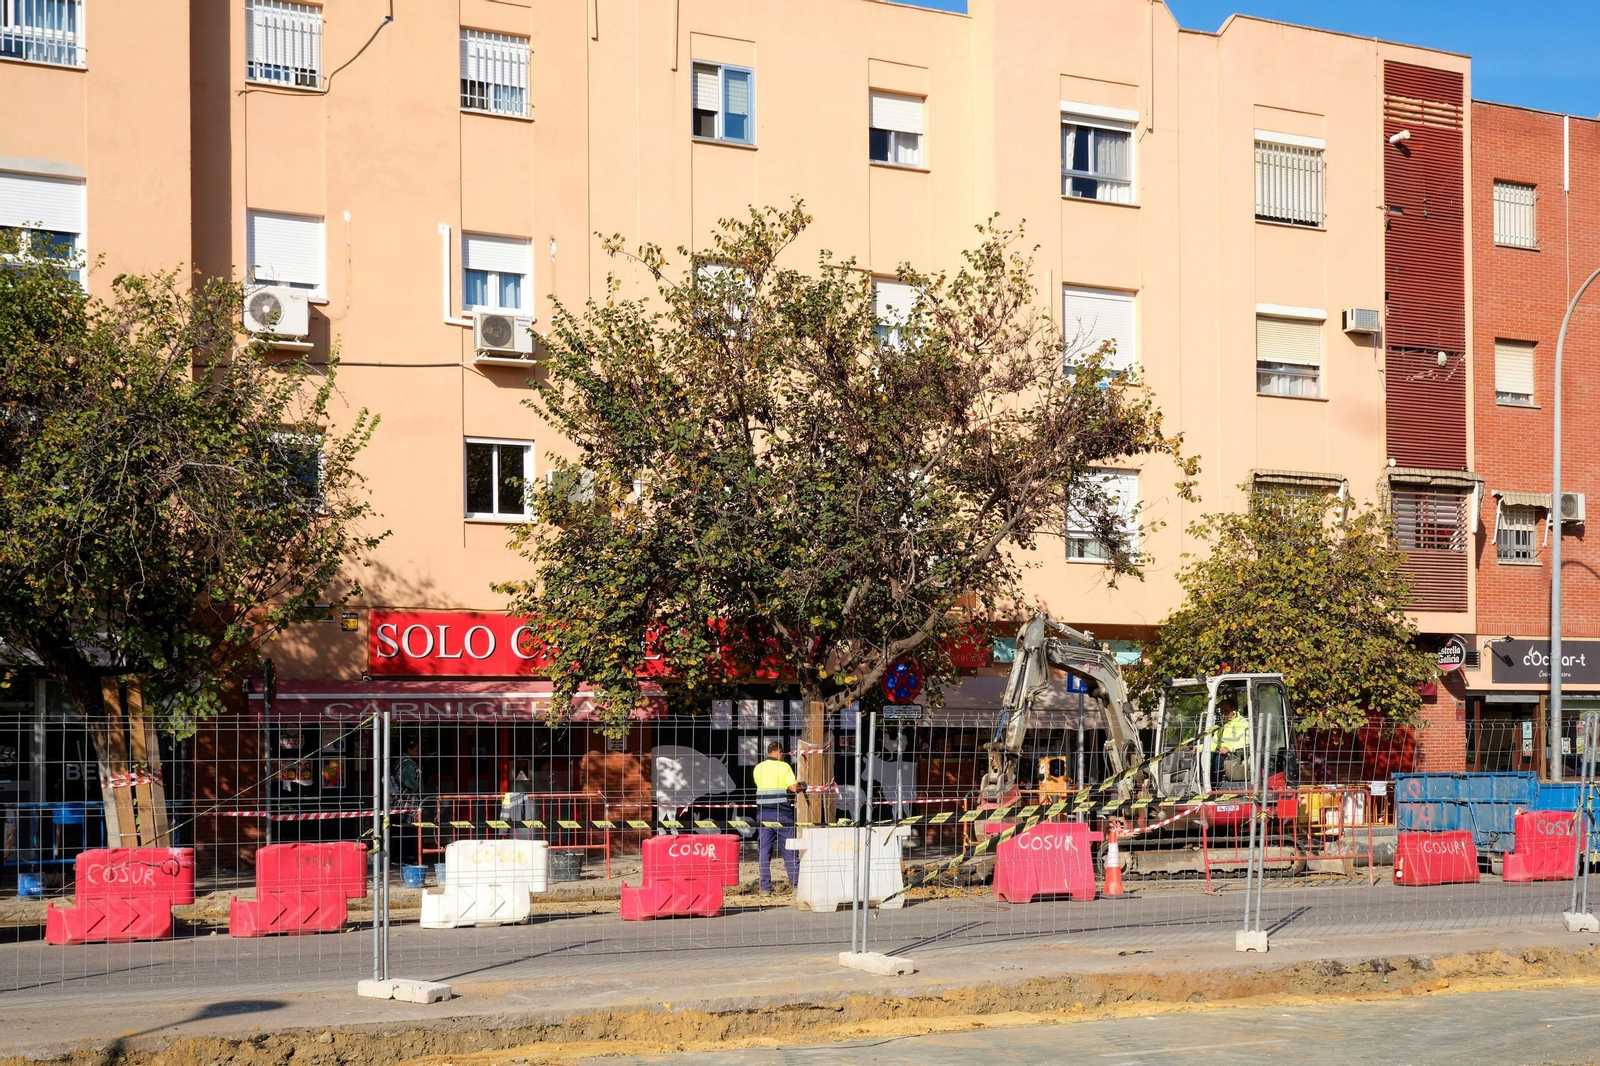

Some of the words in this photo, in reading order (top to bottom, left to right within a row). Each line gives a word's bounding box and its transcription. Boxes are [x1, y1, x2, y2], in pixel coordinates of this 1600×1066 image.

[376, 624, 496, 660] SOLO
[324, 701, 599, 720] CARNICERA
[669, 843, 717, 859] COSUR
[1018, 832, 1078, 852] COSUR
[87, 864, 155, 886] COSUR
